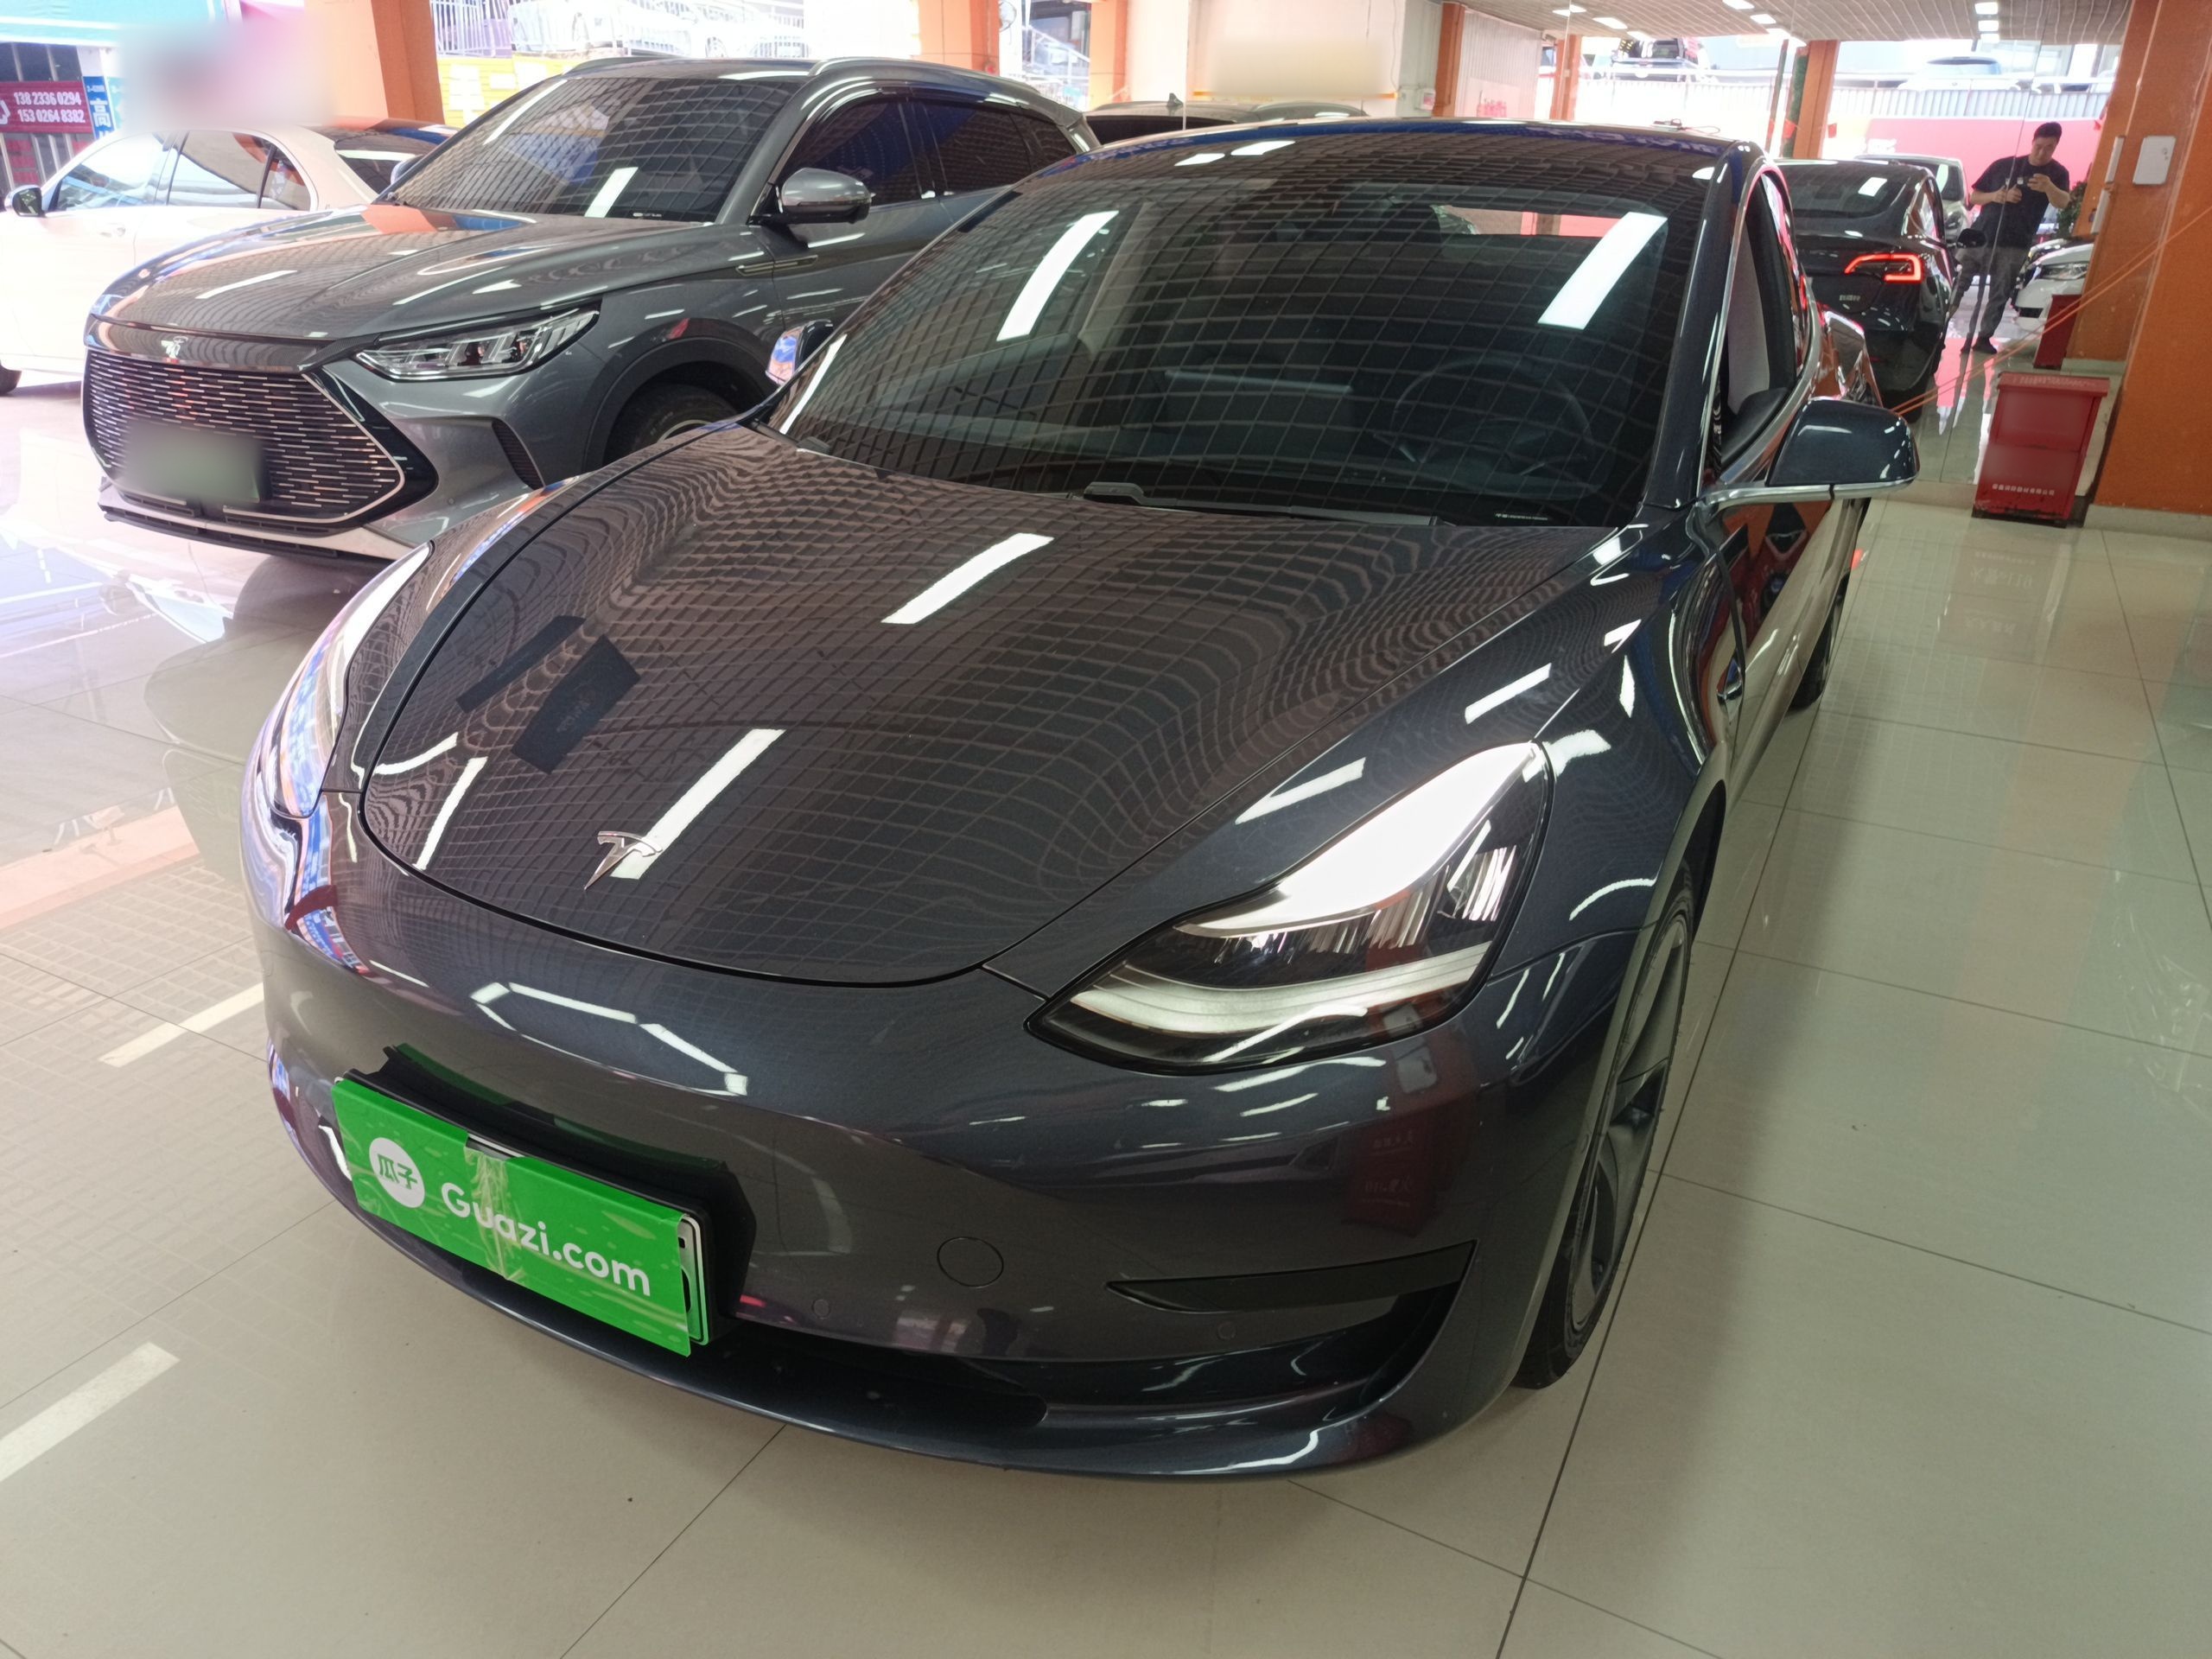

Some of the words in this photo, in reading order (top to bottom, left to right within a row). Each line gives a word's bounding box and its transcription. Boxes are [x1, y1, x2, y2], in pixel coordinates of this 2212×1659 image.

[14, 92, 32, 105] 138
[33, 92, 57, 105] 2336
[57, 92, 82, 105] 0294
[17, 109, 35, 123] 153
[36, 110, 60, 123] 0264
[60, 110, 86, 124] 8382
[377, 1153, 418, 1190] 瓜子
[441, 1182, 651, 1297] Guazi.com
